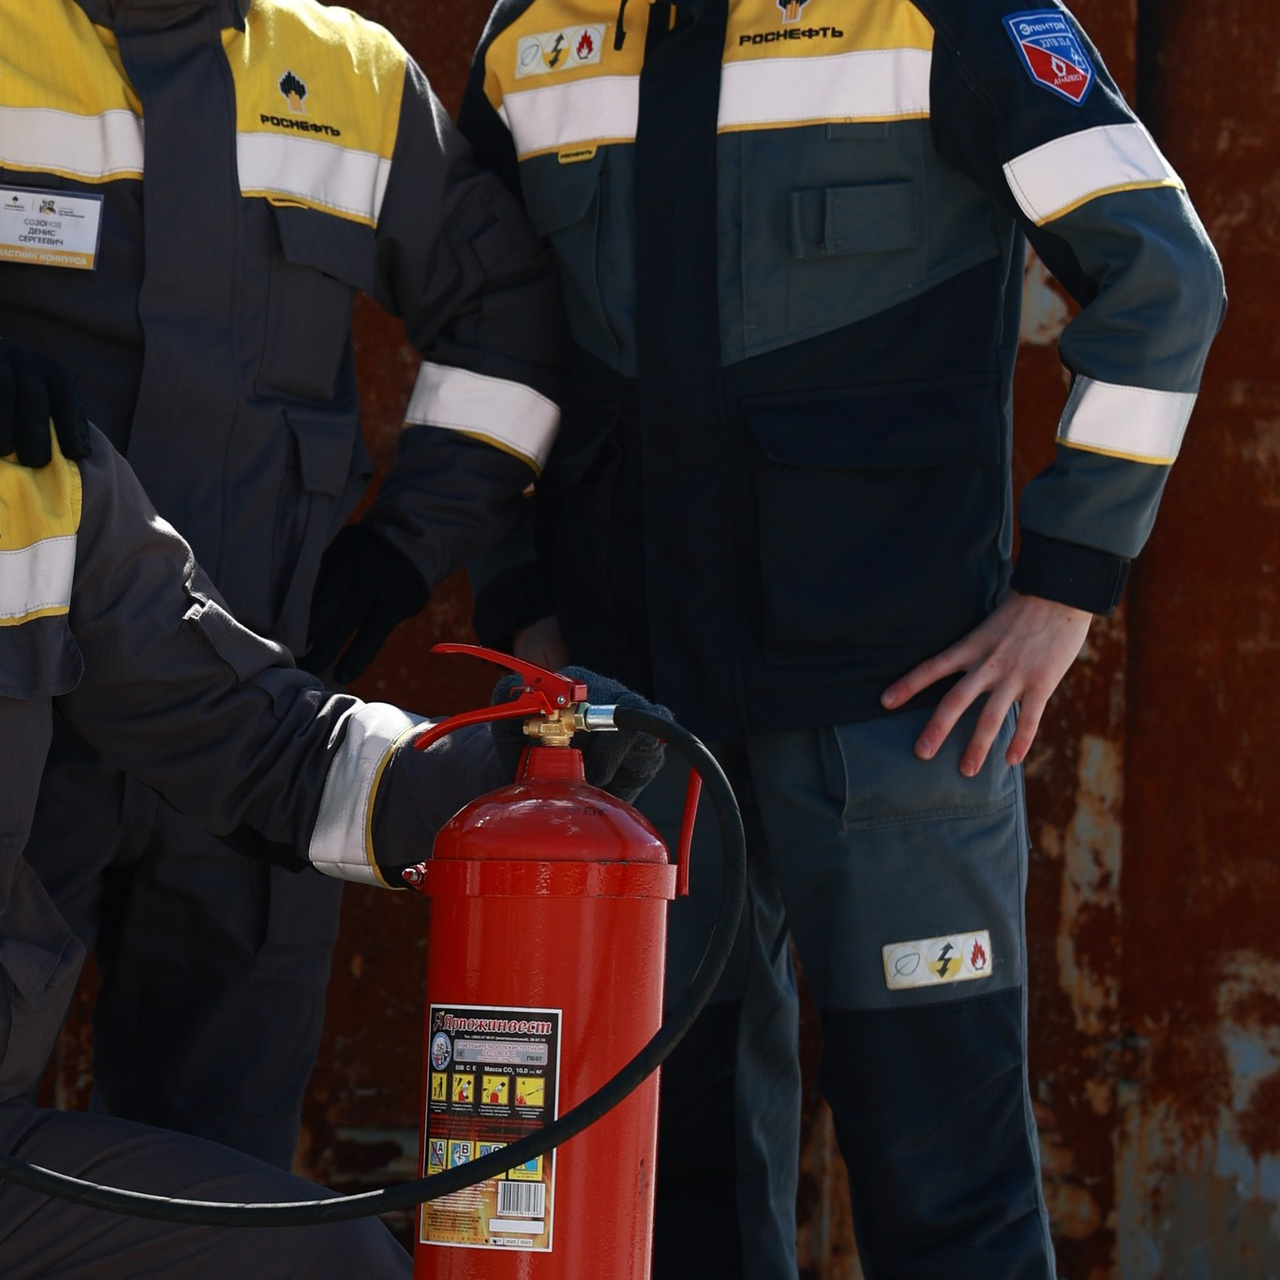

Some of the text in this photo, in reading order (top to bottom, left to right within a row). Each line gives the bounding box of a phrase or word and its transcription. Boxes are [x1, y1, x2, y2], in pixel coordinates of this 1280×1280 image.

[739, 27, 843, 46] РОСНЕФТЬ
[260, 113, 341, 136] РОСНЕФТЬ
[24, 218, 62, 229] СОЗОНОВ
[28, 227, 56, 237] ДЕНИС
[18, 235, 63, 246] СЕРГЕЕВИЧ
[443, 1014, 552, 1036] Ярпожинвест
[437, 1142, 444, 1153] A
[461, 1144, 469, 1154] B
